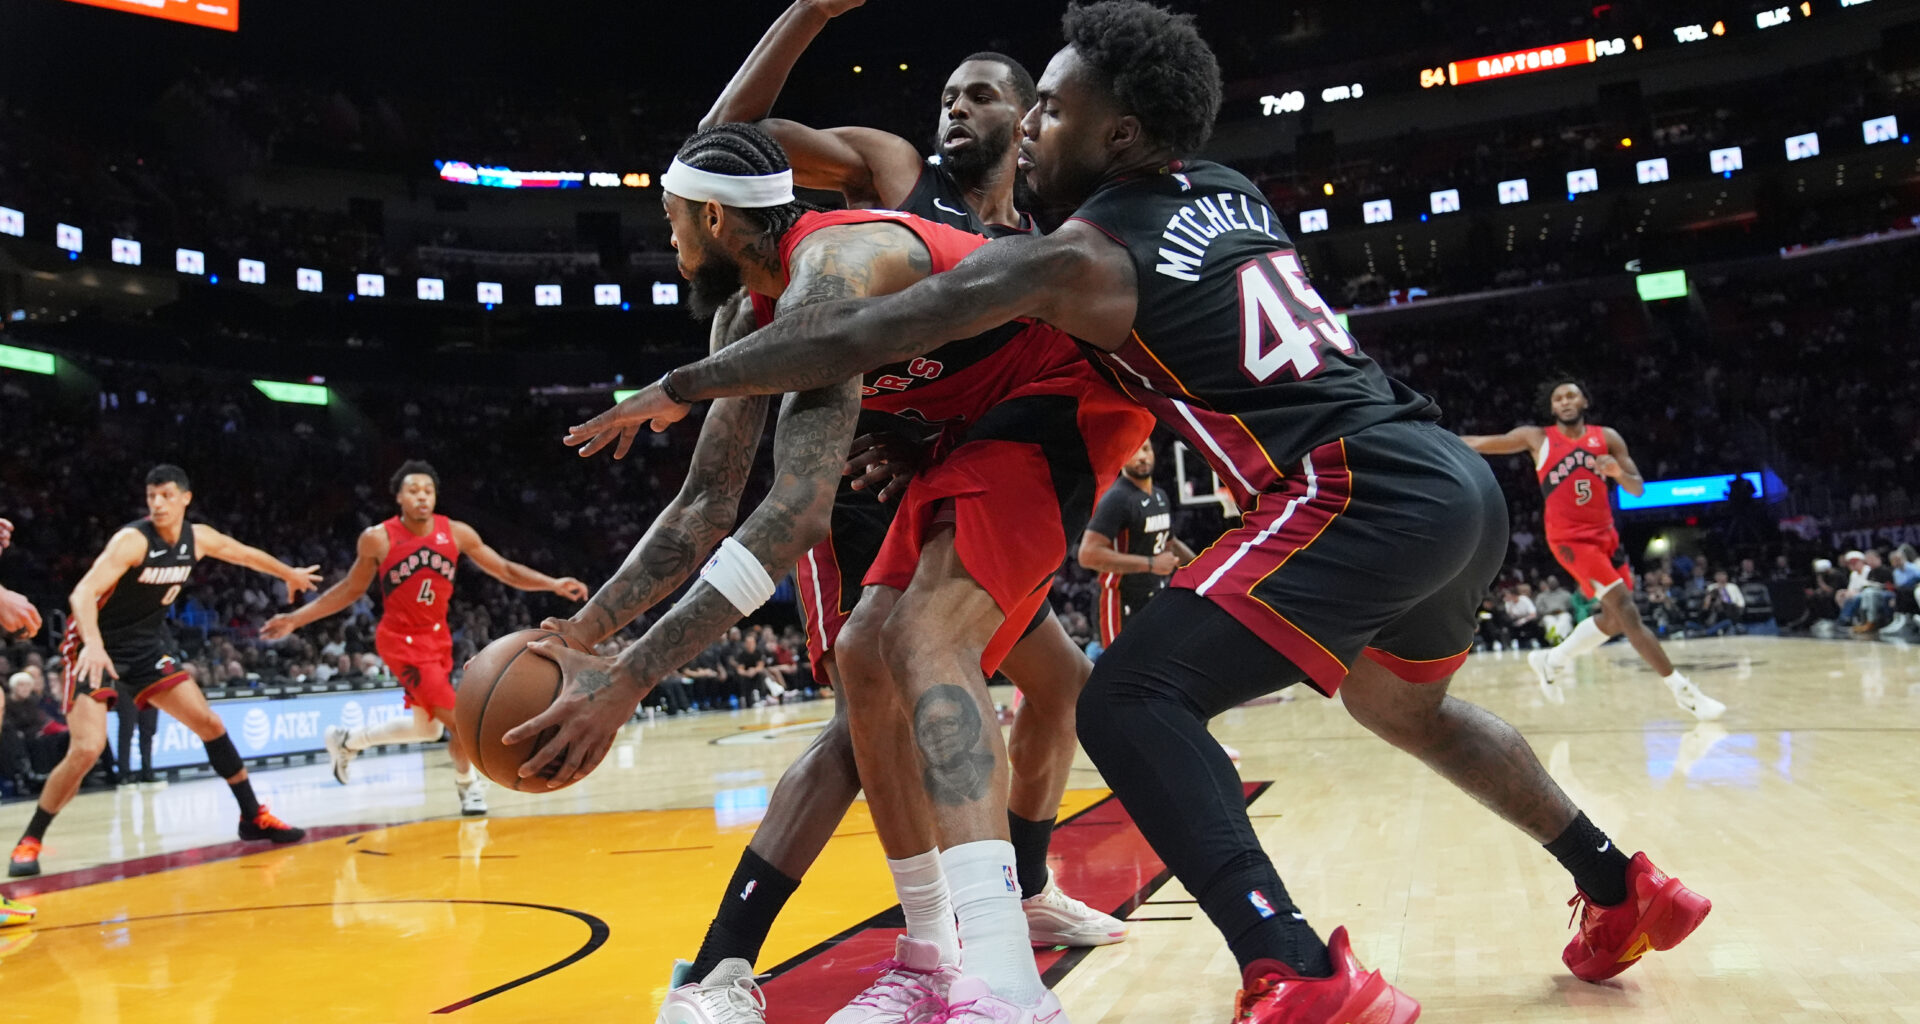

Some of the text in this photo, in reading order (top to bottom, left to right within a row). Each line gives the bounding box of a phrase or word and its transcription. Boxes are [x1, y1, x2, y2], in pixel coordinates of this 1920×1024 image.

[1420, 67, 1446, 88] 54
[1477, 47, 1566, 77] RAPTORS
[1632, 35, 1643, 50] 1
[1712, 20, 1725, 36] 4
[1155, 192, 1279, 282] MITCHELL
[1236, 248, 1356, 386] 45
[1549, 451, 1607, 485] RAPTO
[1574, 479, 1592, 506] 5
[137, 565, 192, 585] MIAMI
[160, 584, 182, 606] 0
[416, 578, 436, 606] 4
[273, 710, 321, 741] AT&T
